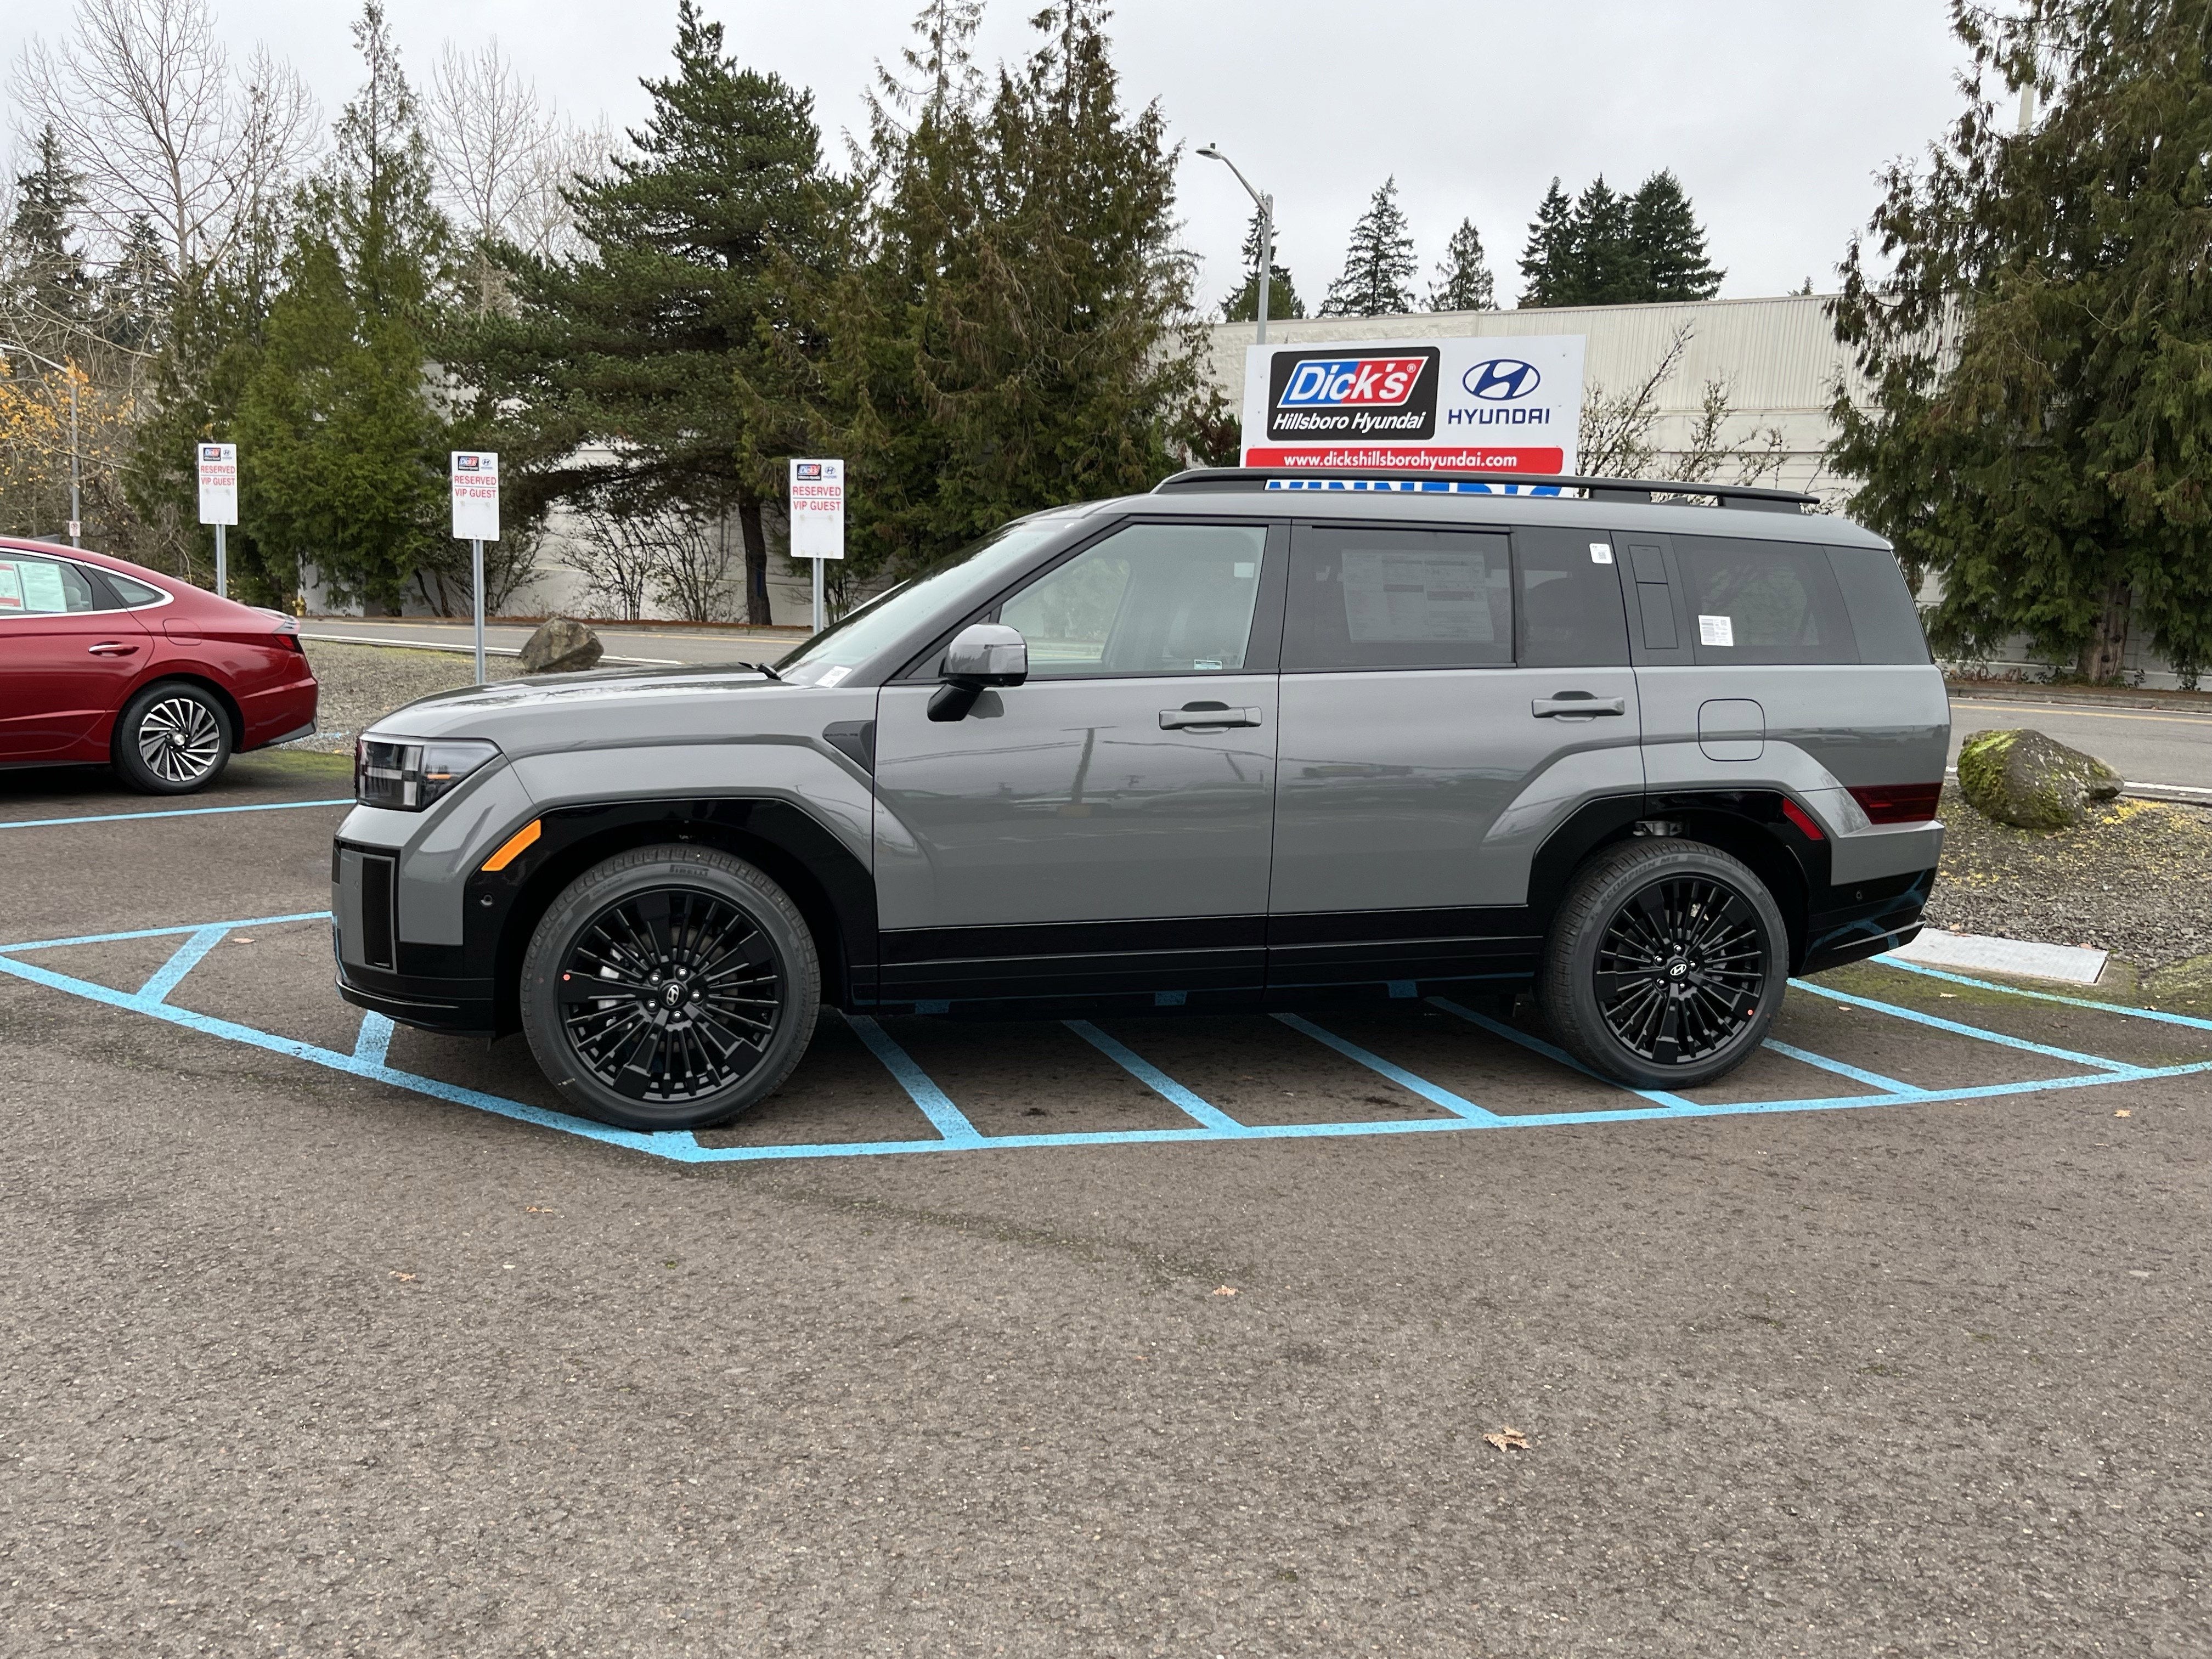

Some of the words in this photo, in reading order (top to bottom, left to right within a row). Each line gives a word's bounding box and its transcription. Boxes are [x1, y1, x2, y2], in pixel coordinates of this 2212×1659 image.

[1288, 363, 1408, 401] Dick's
[1447, 408, 1550, 424] HYUNDAI
[1273, 413, 1350, 430] Hillsboro
[1351, 411, 1427, 433] Hyundai
[1283, 450, 1517, 471] www.dickshillsborohyundai.com
[200, 465, 235, 474] RESERVED
[213, 477, 235, 486] GUEST
[454, 475, 496, 485] RESERVED
[455, 488, 467, 496] VIP
[470, 489, 496, 498] GUEST
[793, 486, 842, 496] RESERVED
[793, 501, 807, 510] VIP
[810, 501, 842, 511] GUEST
